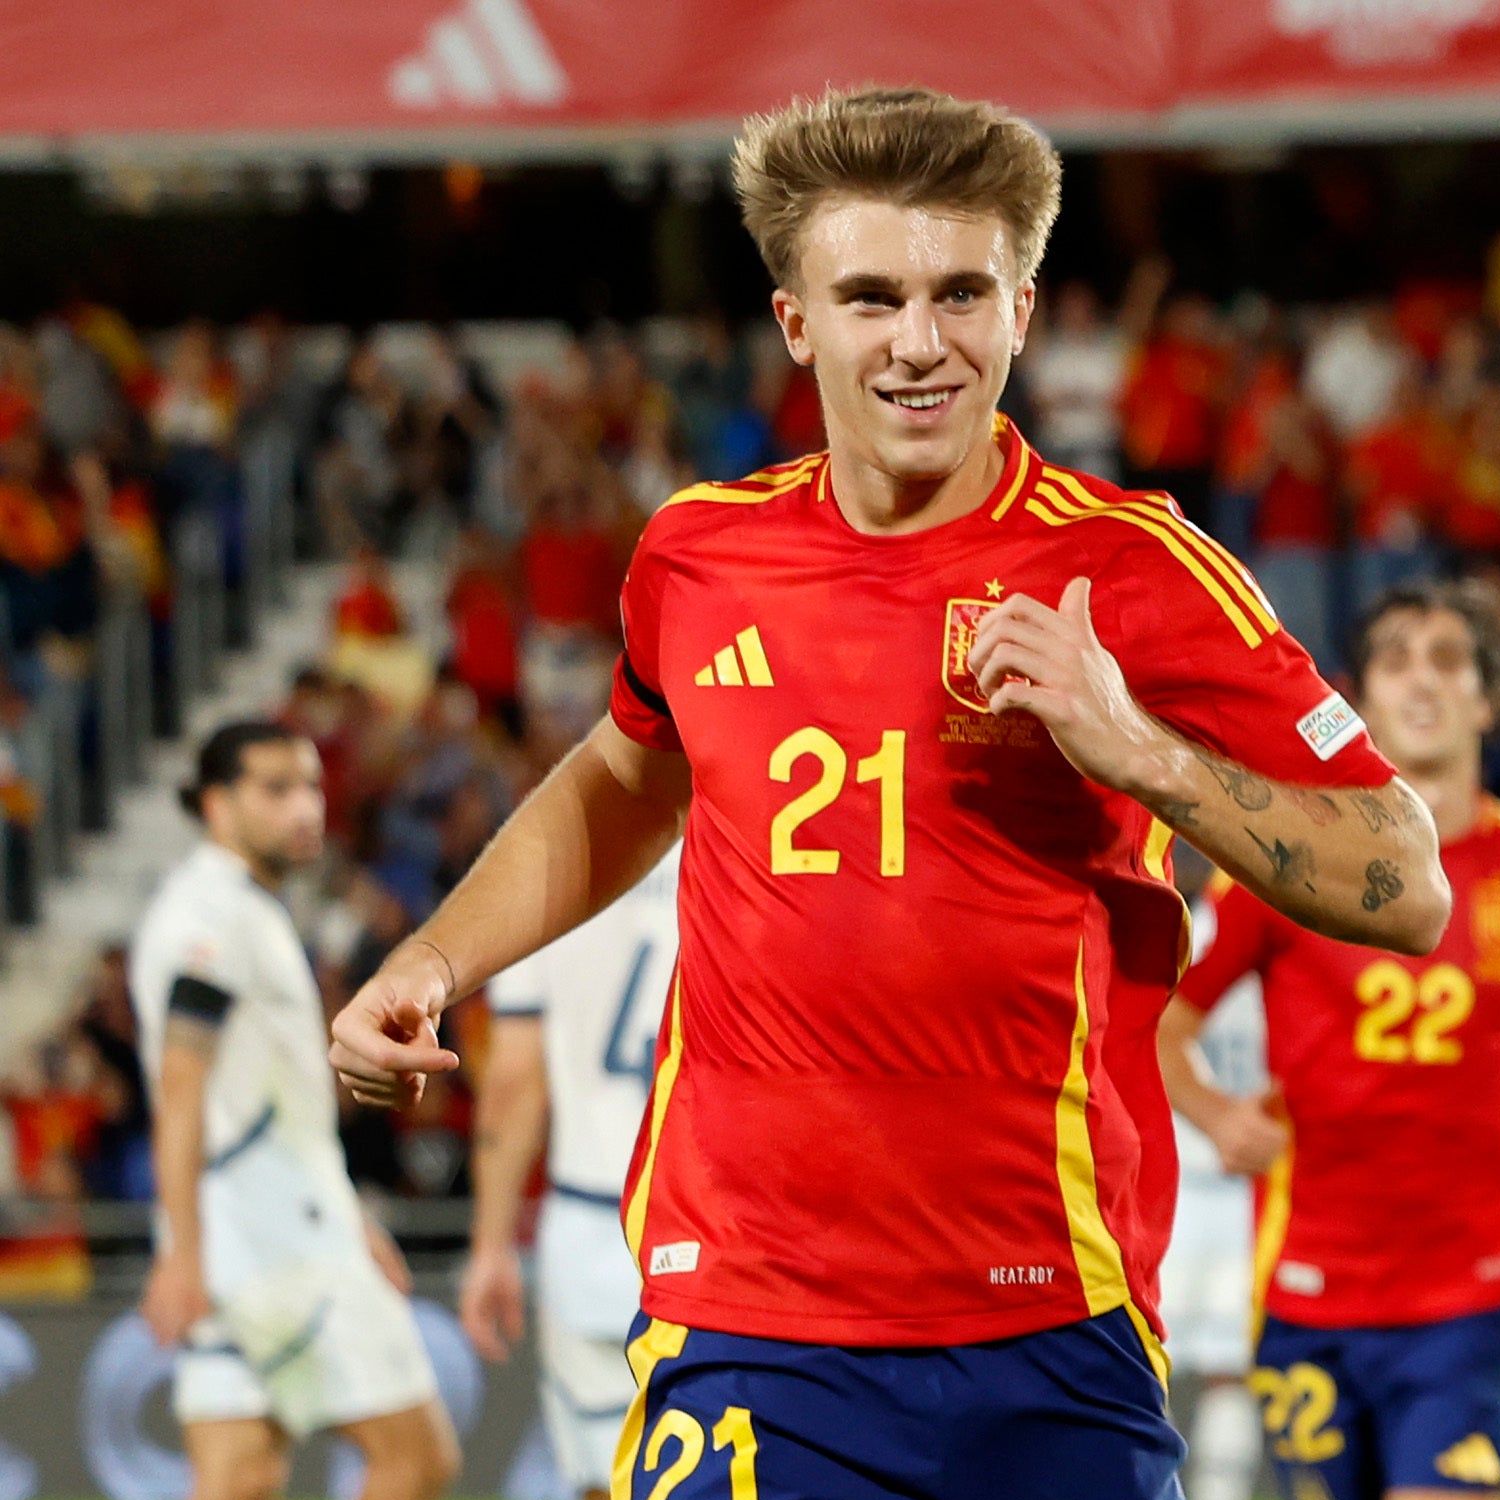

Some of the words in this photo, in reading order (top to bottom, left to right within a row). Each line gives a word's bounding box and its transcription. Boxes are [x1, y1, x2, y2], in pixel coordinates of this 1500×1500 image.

[769, 727, 906, 877] 21
[1354, 961, 1476, 1064] 22
[989, 1265, 1055, 1285] HEAT.RDY
